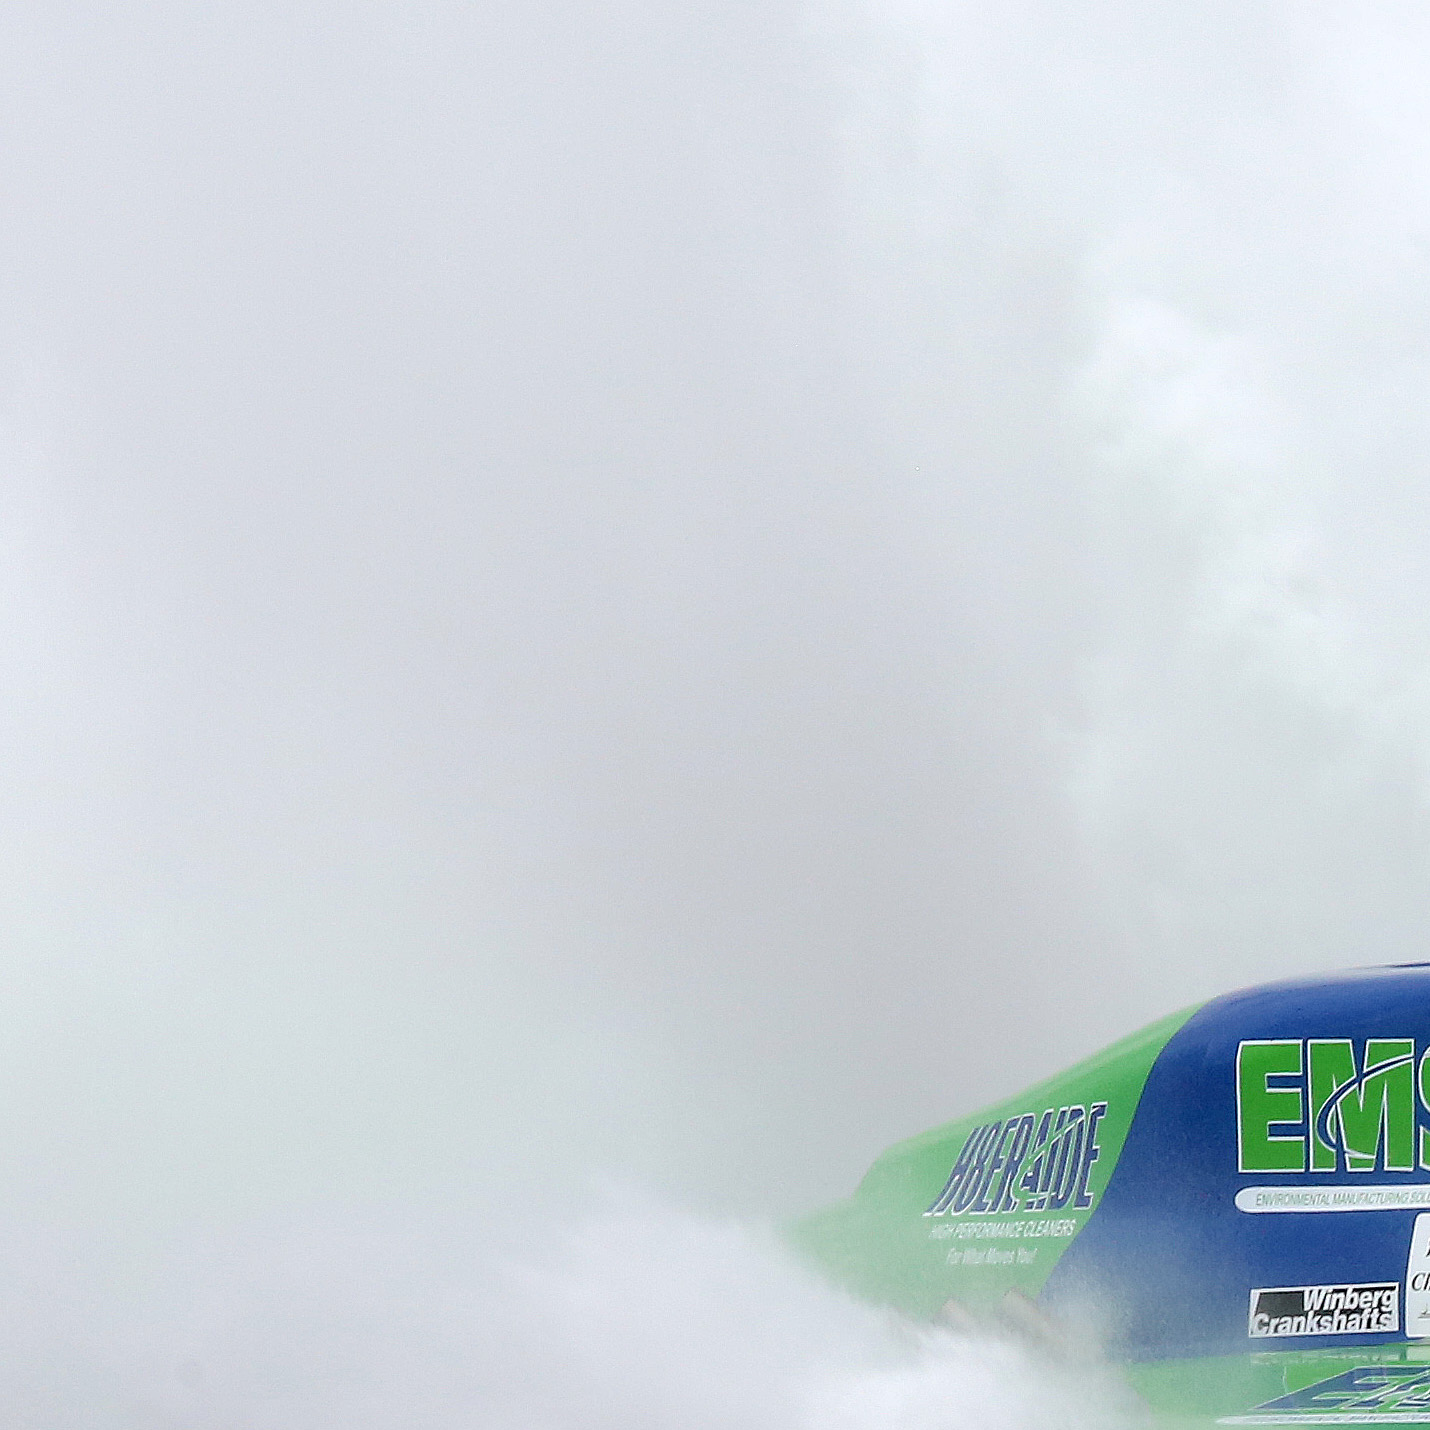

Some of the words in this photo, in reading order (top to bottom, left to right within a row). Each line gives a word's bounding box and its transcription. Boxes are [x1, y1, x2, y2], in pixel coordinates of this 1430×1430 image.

[1255, 1191, 1330, 1207] ENVIRONMENTAL
[1331, 1190, 1406, 1206] MANUFACTURING
[955, 1220, 1025, 1239] PERFORMANCE
[1023, 1218, 1077, 1238] CLEANERS
[1303, 1288, 1396, 1312] Winberg
[1251, 1308, 1394, 1335] Crankshafts
